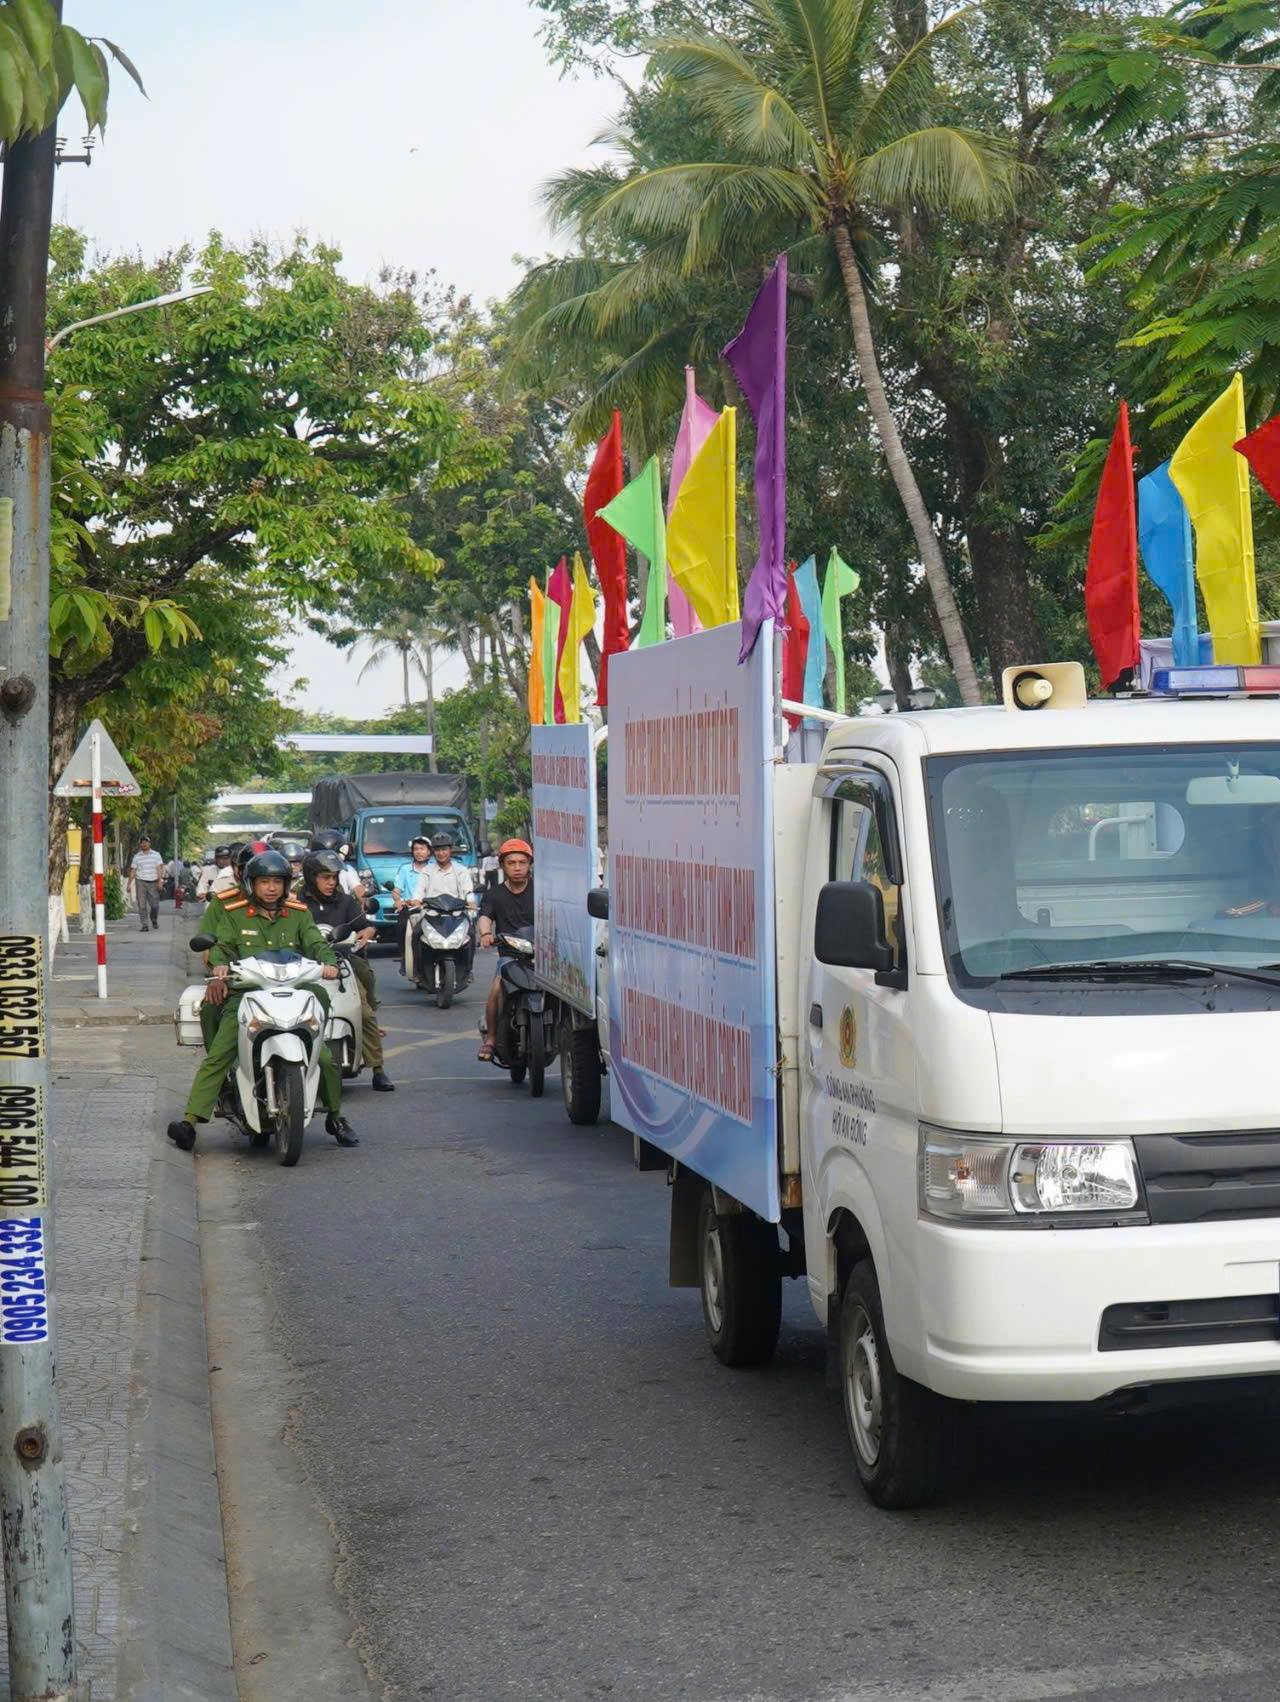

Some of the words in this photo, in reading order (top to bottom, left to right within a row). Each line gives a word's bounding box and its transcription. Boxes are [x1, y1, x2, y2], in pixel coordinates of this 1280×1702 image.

[0, 935, 36, 981] 0933
[0, 986, 38, 1021] 032
[0, 1025, 40, 1058] 567
[0, 1086, 37, 1129] 0906
[0, 1135, 38, 1168] 544
[0, 1174, 40, 1207] 100
